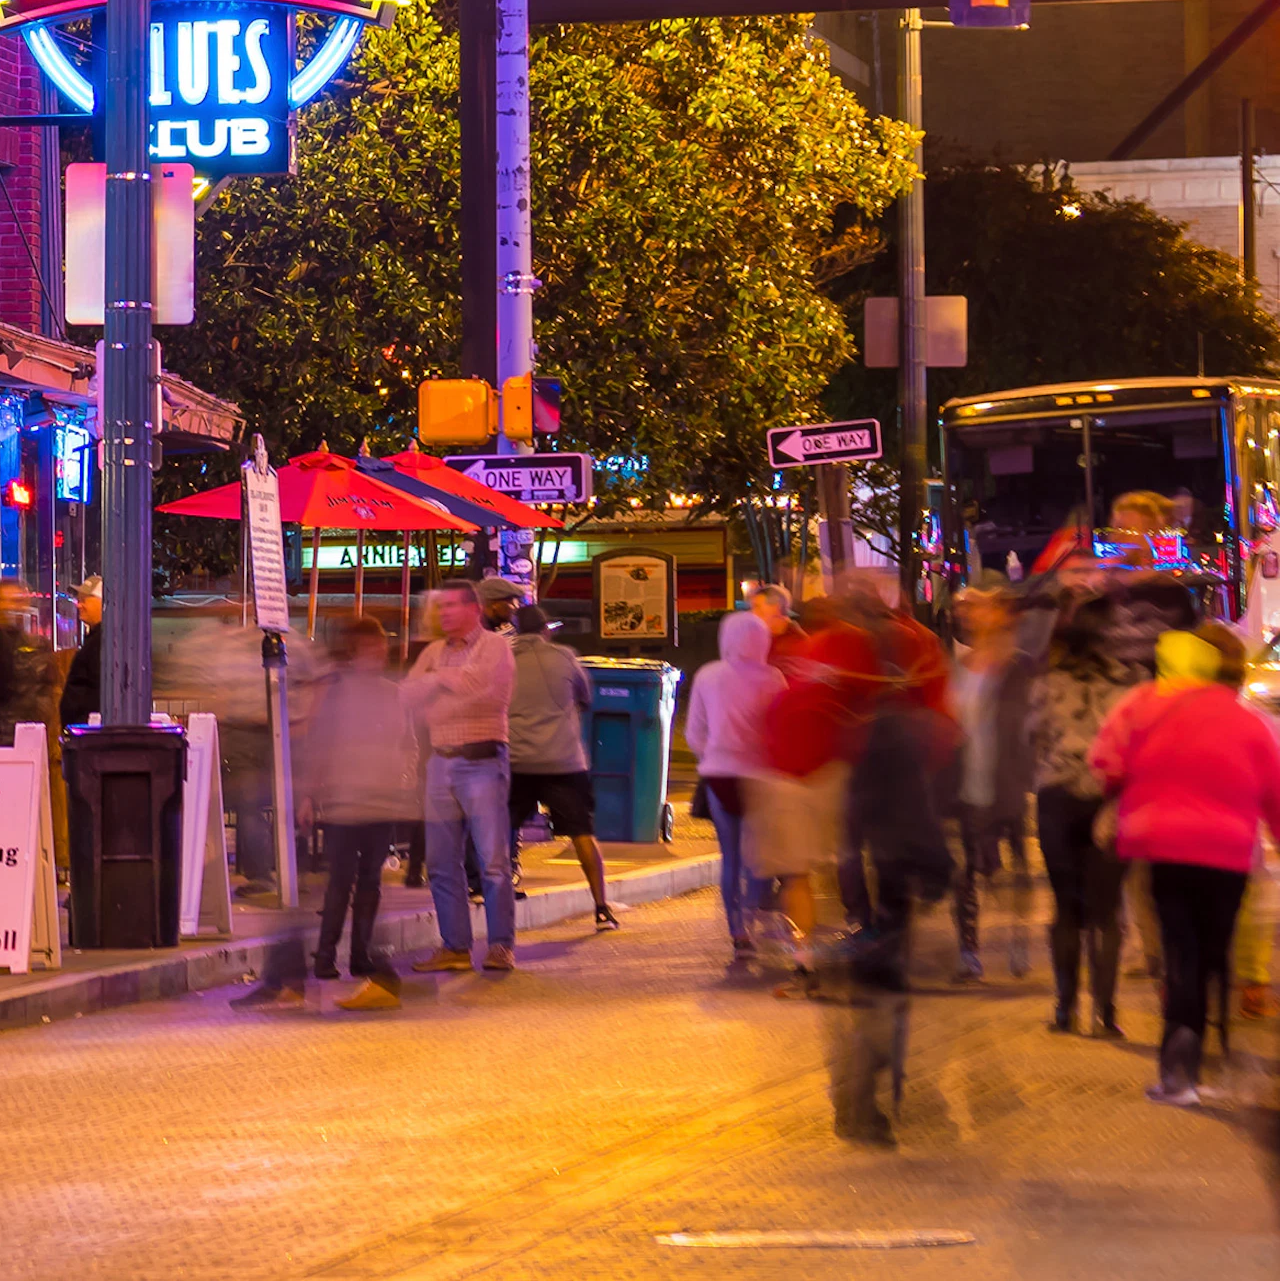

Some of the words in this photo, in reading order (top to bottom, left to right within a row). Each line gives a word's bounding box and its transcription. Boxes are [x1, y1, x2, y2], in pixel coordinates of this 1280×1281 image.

[148, 19, 275, 108] LUES
[148, 115, 270, 159] LUB
[836, 430, 866, 448] WAY
[485, 471, 522, 489] ONE
[530, 469, 568, 488] WAY
